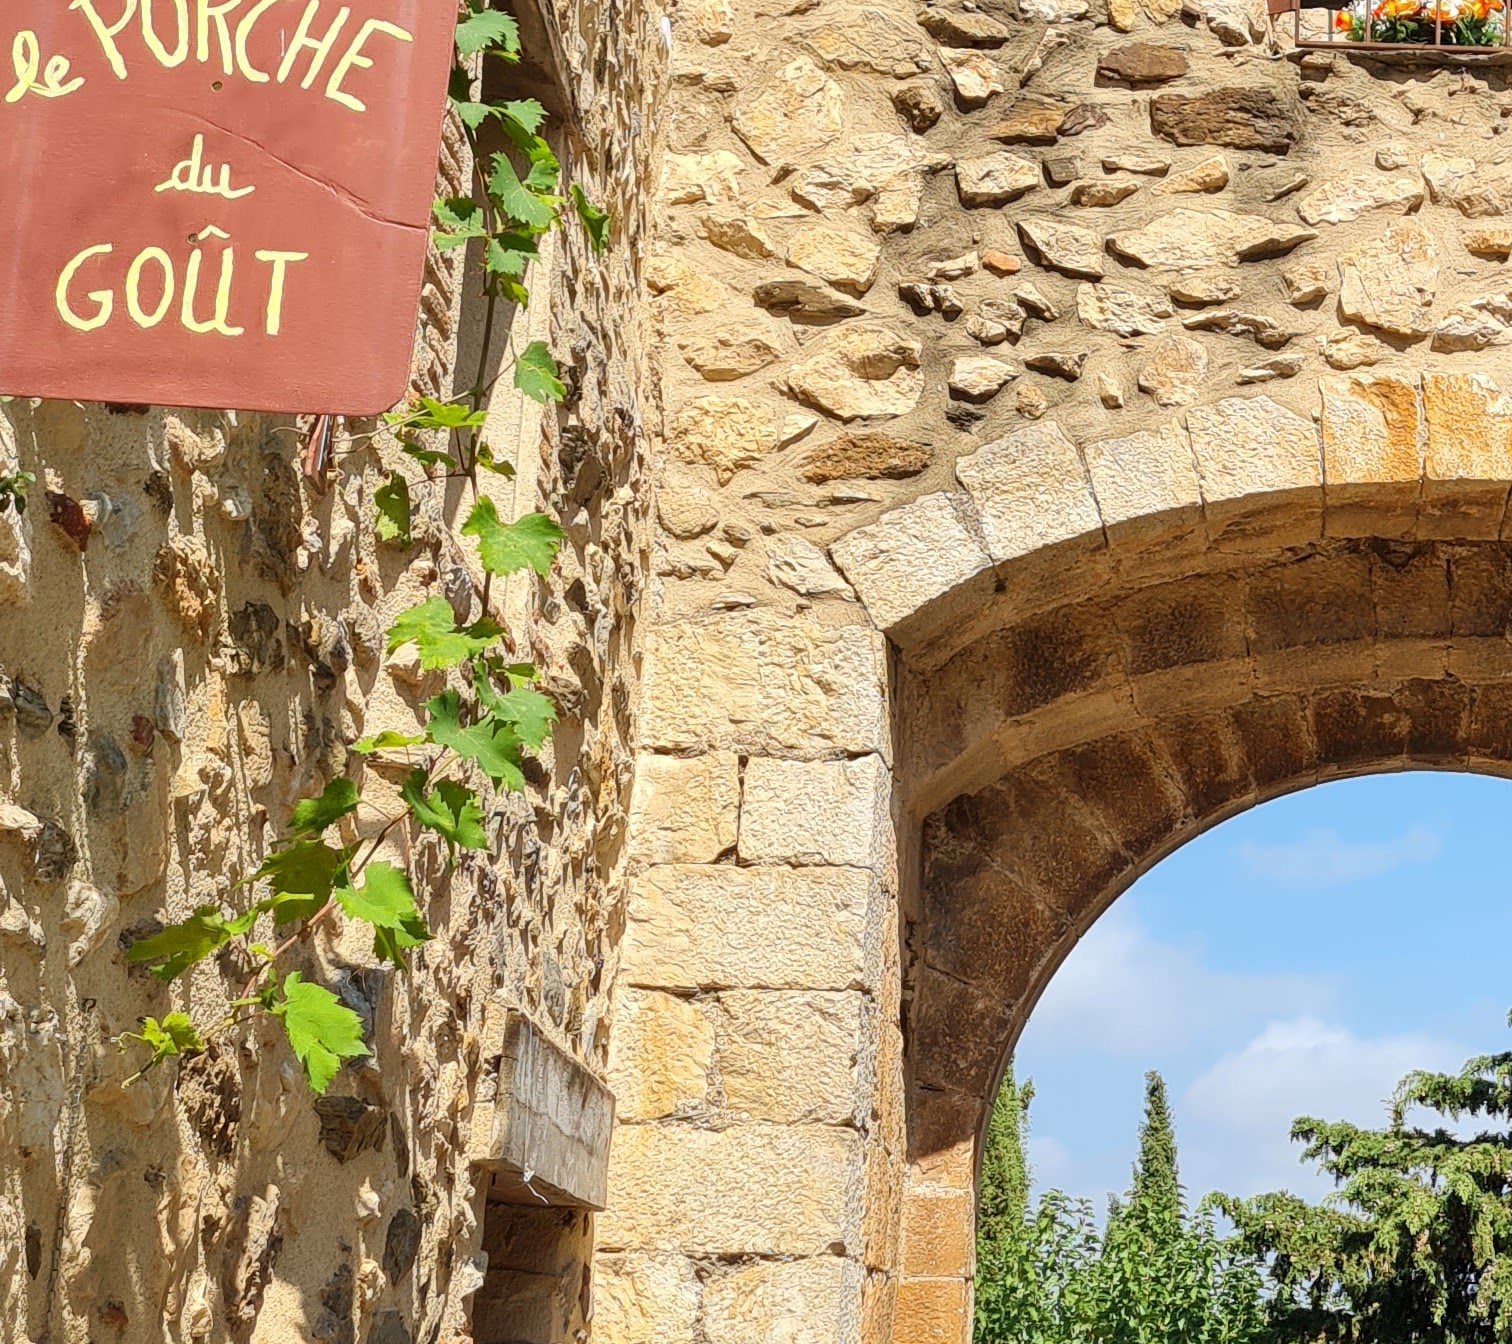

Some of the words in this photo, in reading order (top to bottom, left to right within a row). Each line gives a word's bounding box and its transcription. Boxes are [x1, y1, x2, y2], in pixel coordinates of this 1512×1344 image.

[5, 30, 85, 103] le
[154, 133, 256, 199] du
[55, 224, 309, 337] GOÛT
